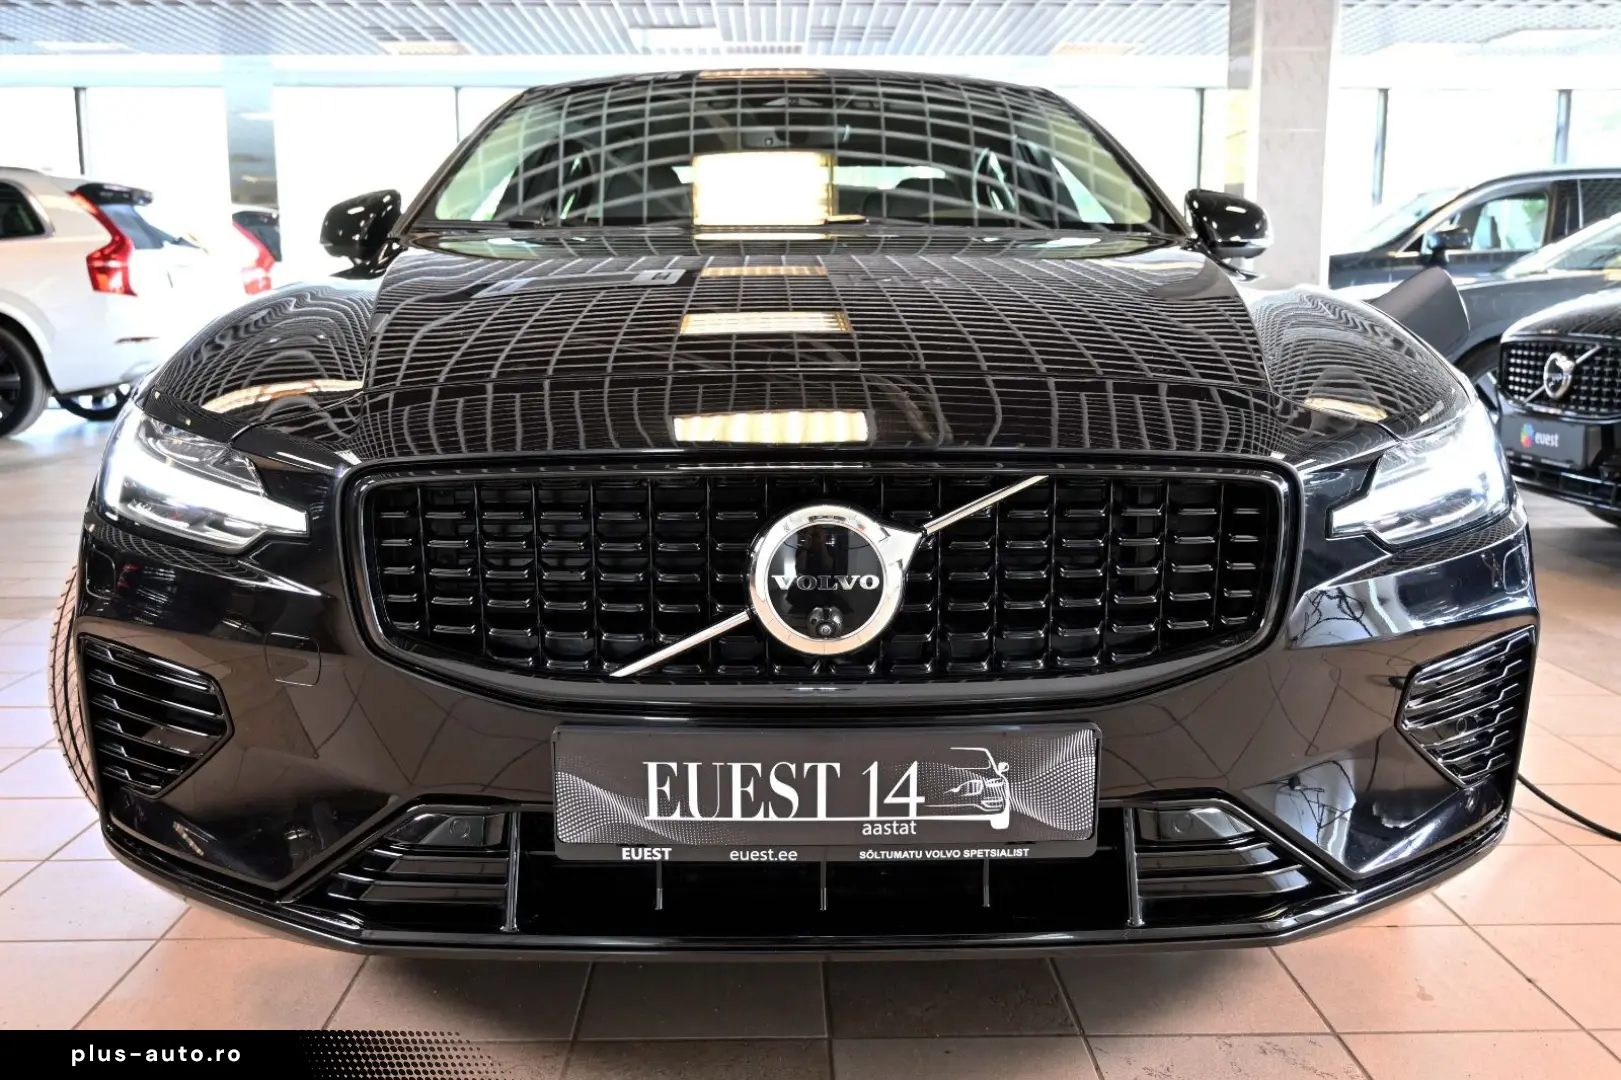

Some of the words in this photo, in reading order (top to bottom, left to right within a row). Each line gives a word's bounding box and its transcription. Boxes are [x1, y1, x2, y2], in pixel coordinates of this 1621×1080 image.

[1535, 431, 1559, 448] euest
[771, 574, 880, 591] VOLVO
[642, 762, 840, 819] EUEST
[862, 760, 925, 818] 14
[862, 820, 917, 836] aastat
[621, 847, 672, 860] EUEST
[729, 848, 798, 861] euest.ee
[859, 849, 923, 859] SÕLTUMATU
[925, 849, 961, 858] VOLVO
[963, 848, 1030, 858] SPETSIALIST
